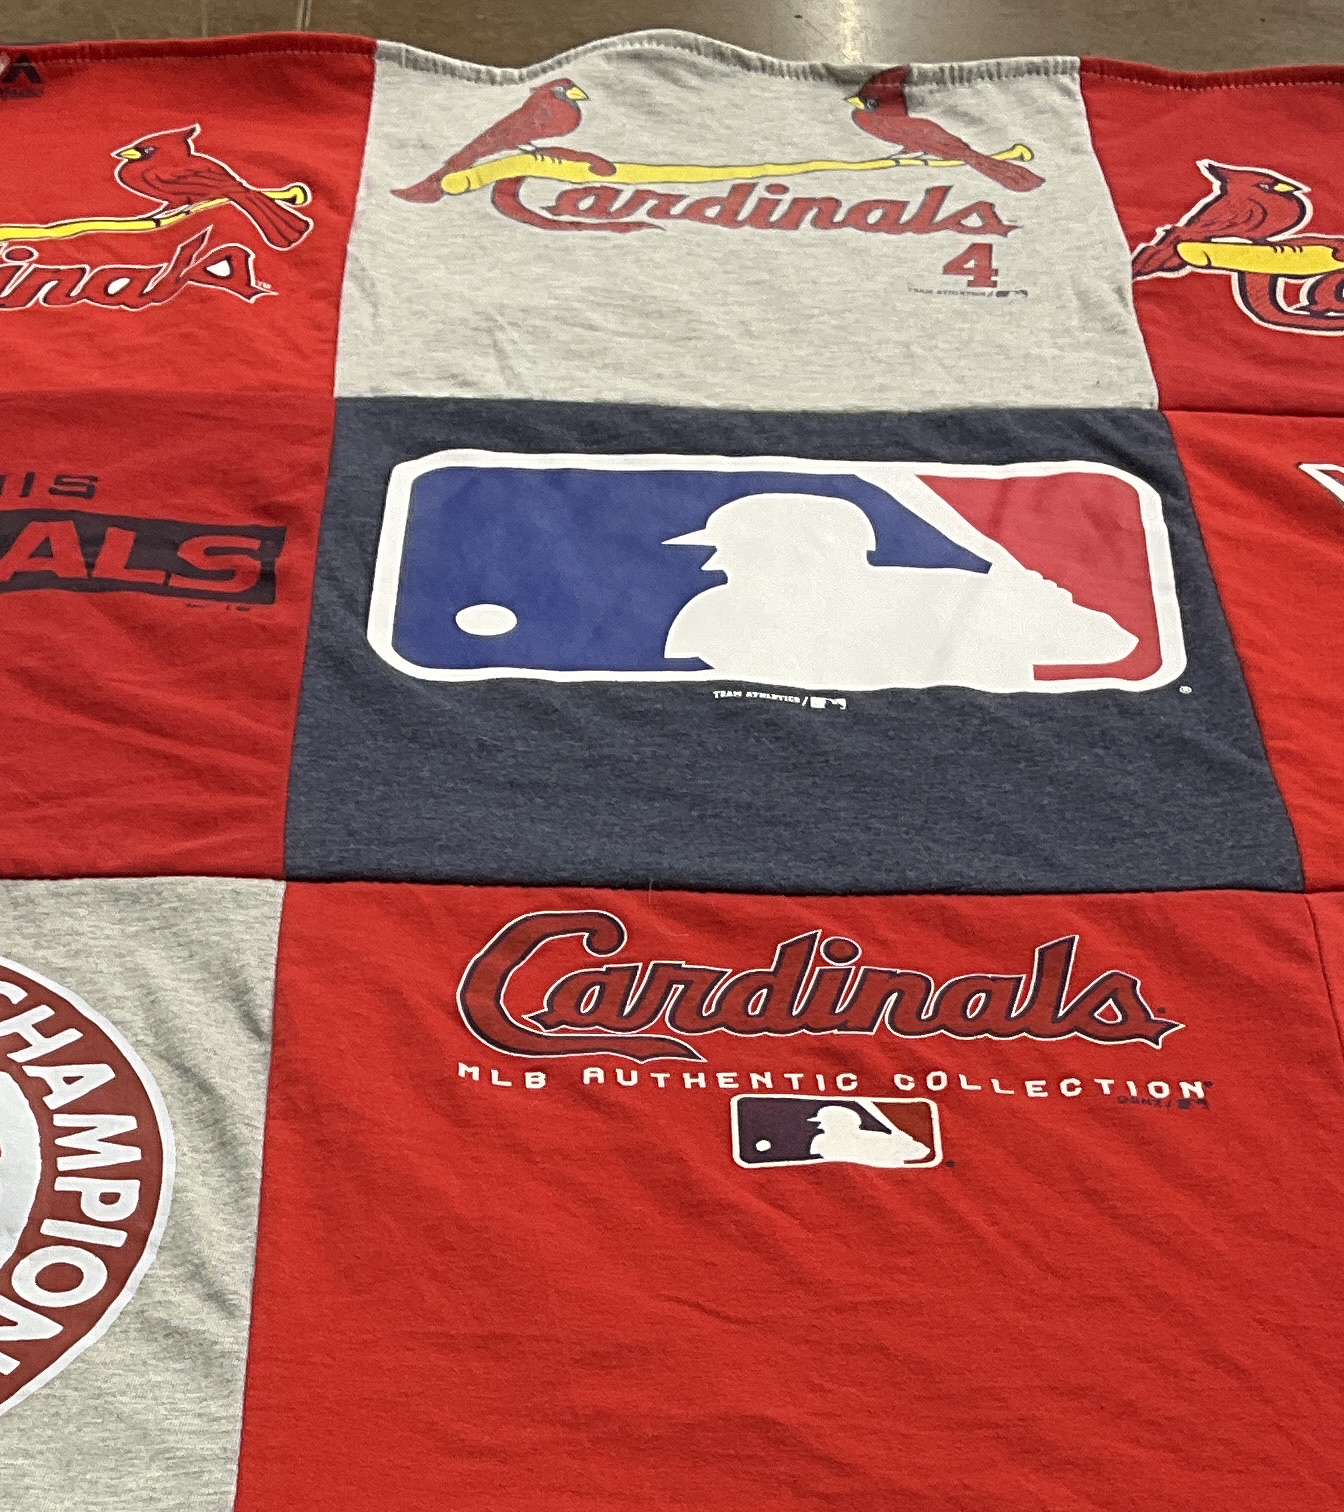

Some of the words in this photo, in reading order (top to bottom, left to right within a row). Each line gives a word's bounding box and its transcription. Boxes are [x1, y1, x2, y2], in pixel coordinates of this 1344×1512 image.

[491, 152, 1022, 237] Cardinals
[942, 242, 999, 288] 4
[456, 909, 1185, 1063] Cardinals
[457, 1062, 547, 1089] MLB
[582, 1066, 859, 1093] AUTHENTIC
[892, 1071, 1206, 1099] COLLECTION
